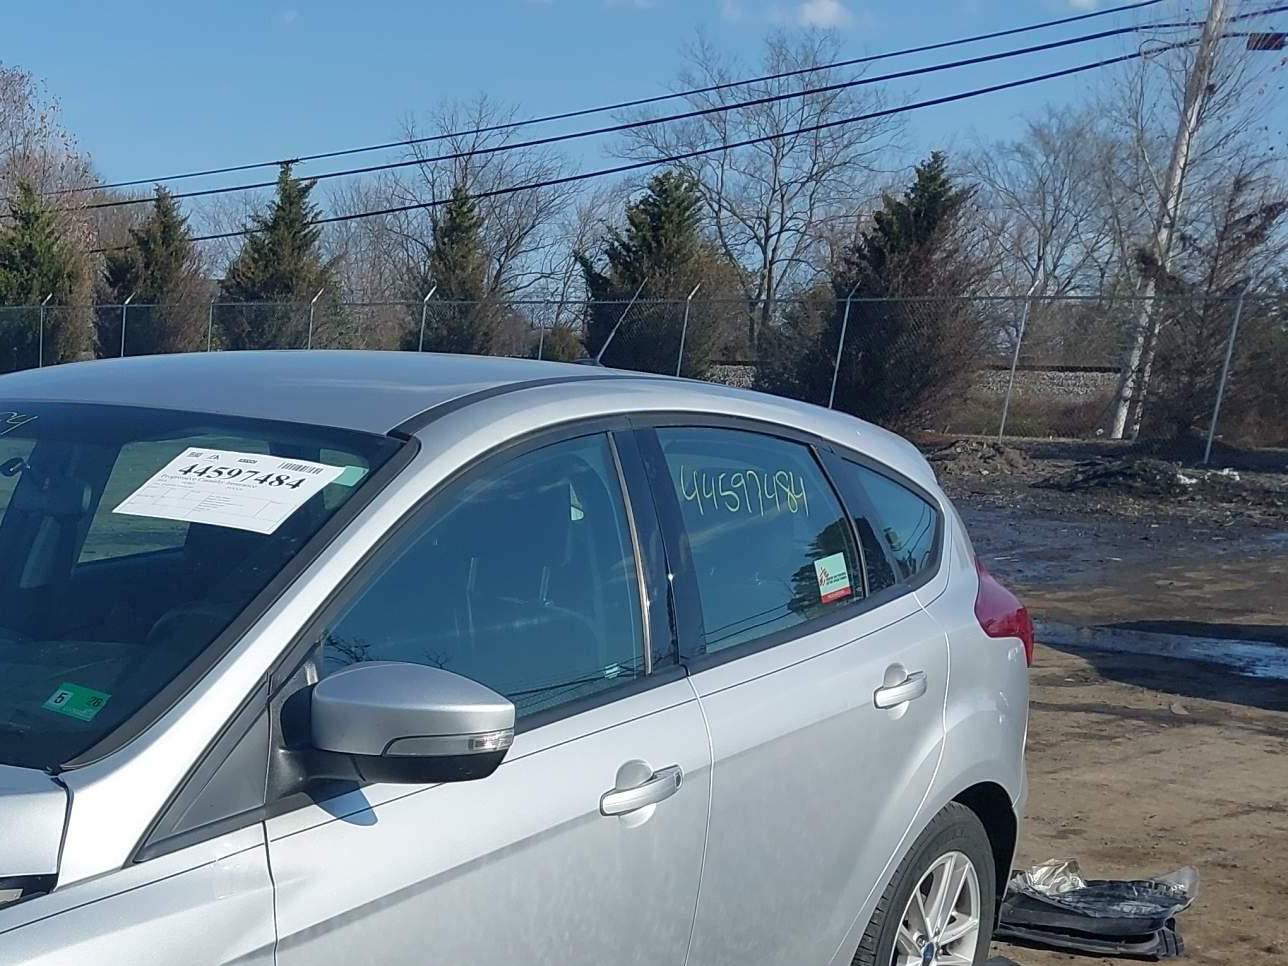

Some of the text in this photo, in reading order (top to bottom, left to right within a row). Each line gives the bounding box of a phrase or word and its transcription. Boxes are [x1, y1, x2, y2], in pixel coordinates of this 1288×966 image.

[178, 462, 306, 490] 44597484
[679, 464, 810, 517] 44597484
[54, 692, 69, 704] 5
